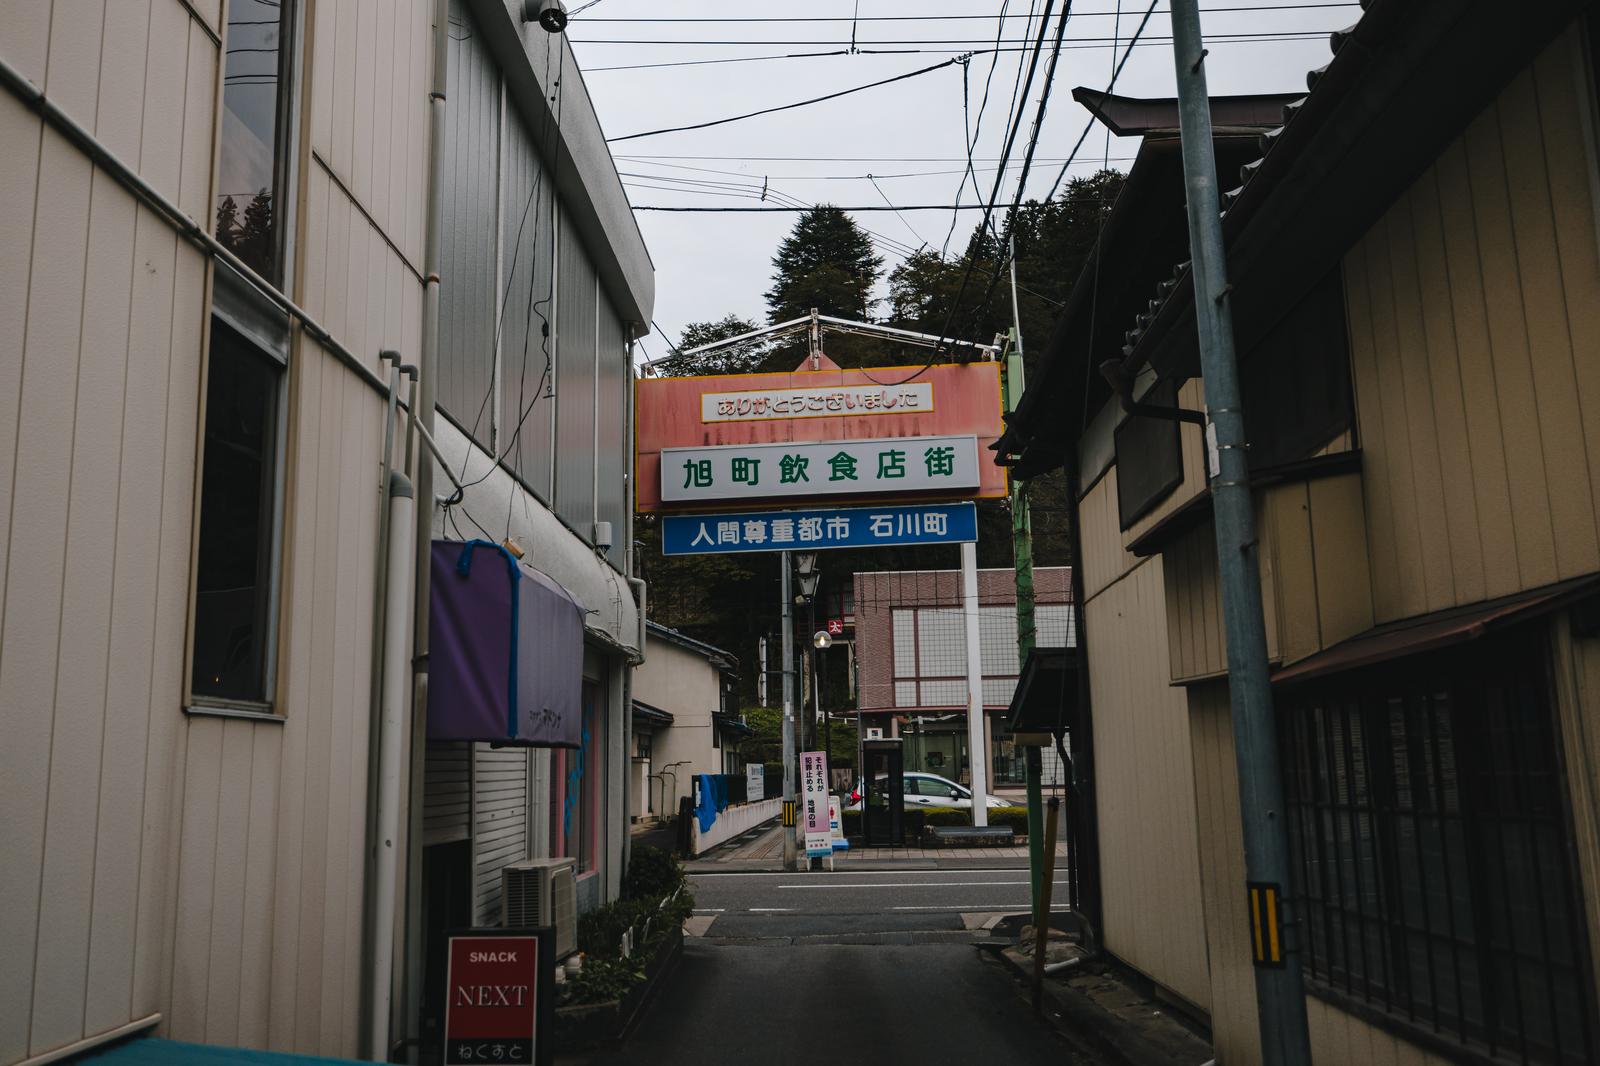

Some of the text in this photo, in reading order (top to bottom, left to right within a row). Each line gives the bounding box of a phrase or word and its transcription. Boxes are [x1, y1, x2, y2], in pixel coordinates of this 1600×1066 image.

[717, 389, 919, 416] ありがとうございました
[683, 446, 955, 489] 旭町飲食店街
[690, 512, 948, 547] 人間尊重都市 石川町
[469, 951, 518, 963] SNACK
[456, 985, 528, 1007] NEXT
[458, 1043, 523, 1060] ねくすと
